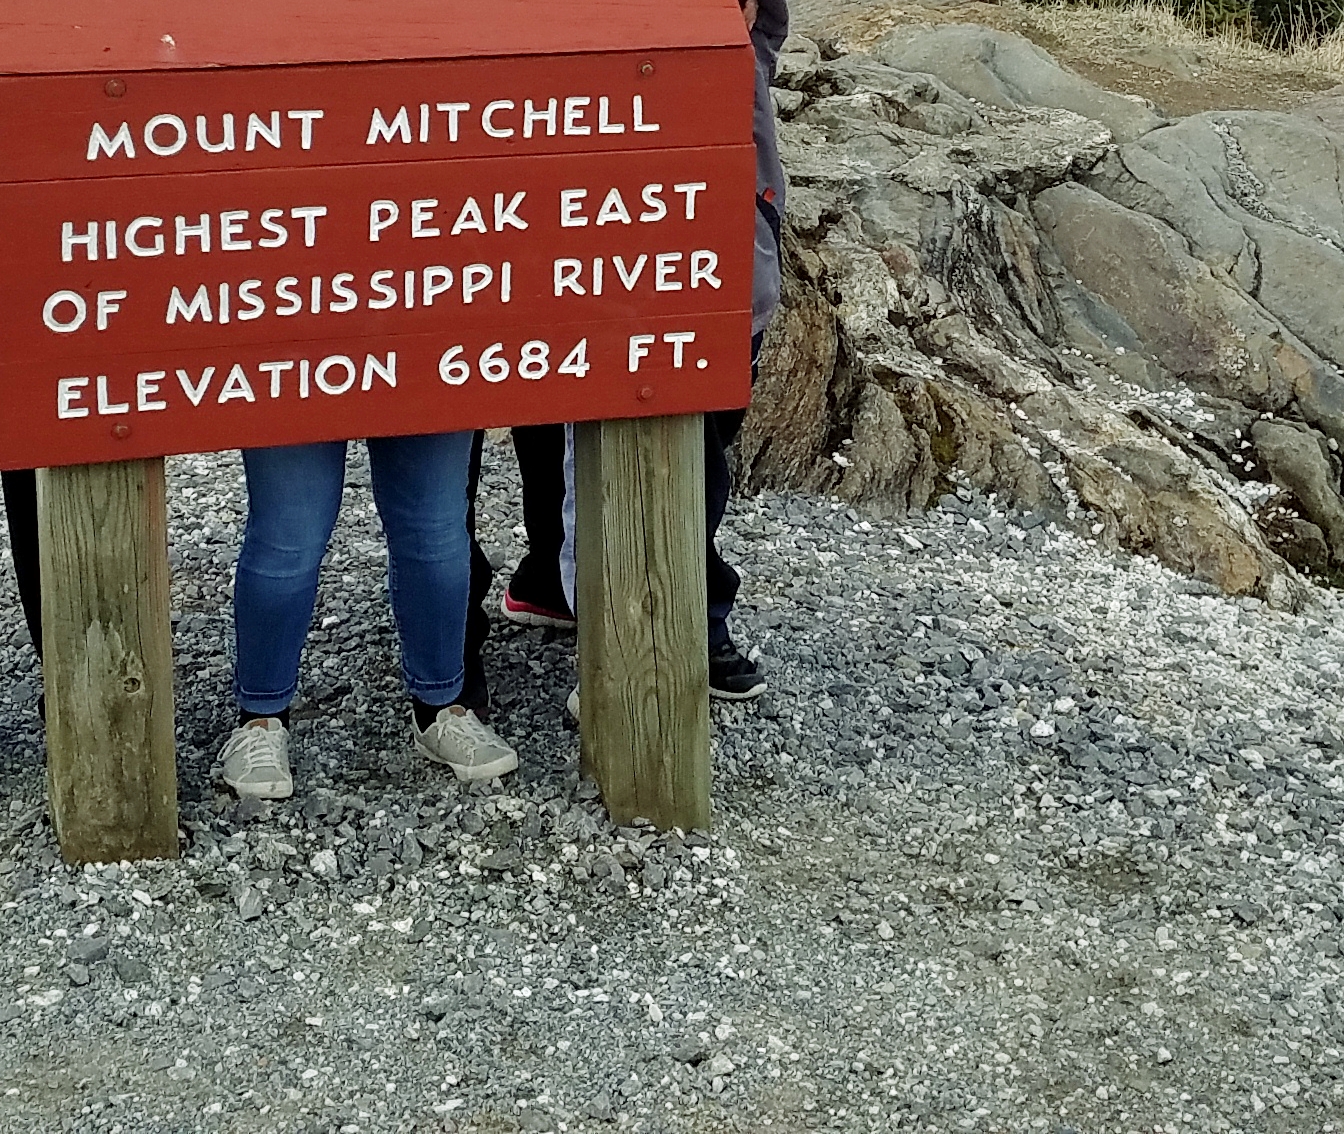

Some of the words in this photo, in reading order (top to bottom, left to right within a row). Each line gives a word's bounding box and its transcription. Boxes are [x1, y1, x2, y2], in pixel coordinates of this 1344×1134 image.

[84, 108, 325, 162] MOUNT
[364, 93, 661, 146] MITCHELL
[60, 204, 329, 264] HIGHEST
[368, 190, 530, 243] PEAK
[559, 180, 708, 229] EAST
[41, 288, 129, 335] OF
[164, 260, 513, 326] MISSISSIPPI
[552, 248, 723, 298] RIVER
[56, 350, 398, 421] ELEVATION
[437, 336, 592, 387] 6684
[627, 330, 711, 374] FT.
